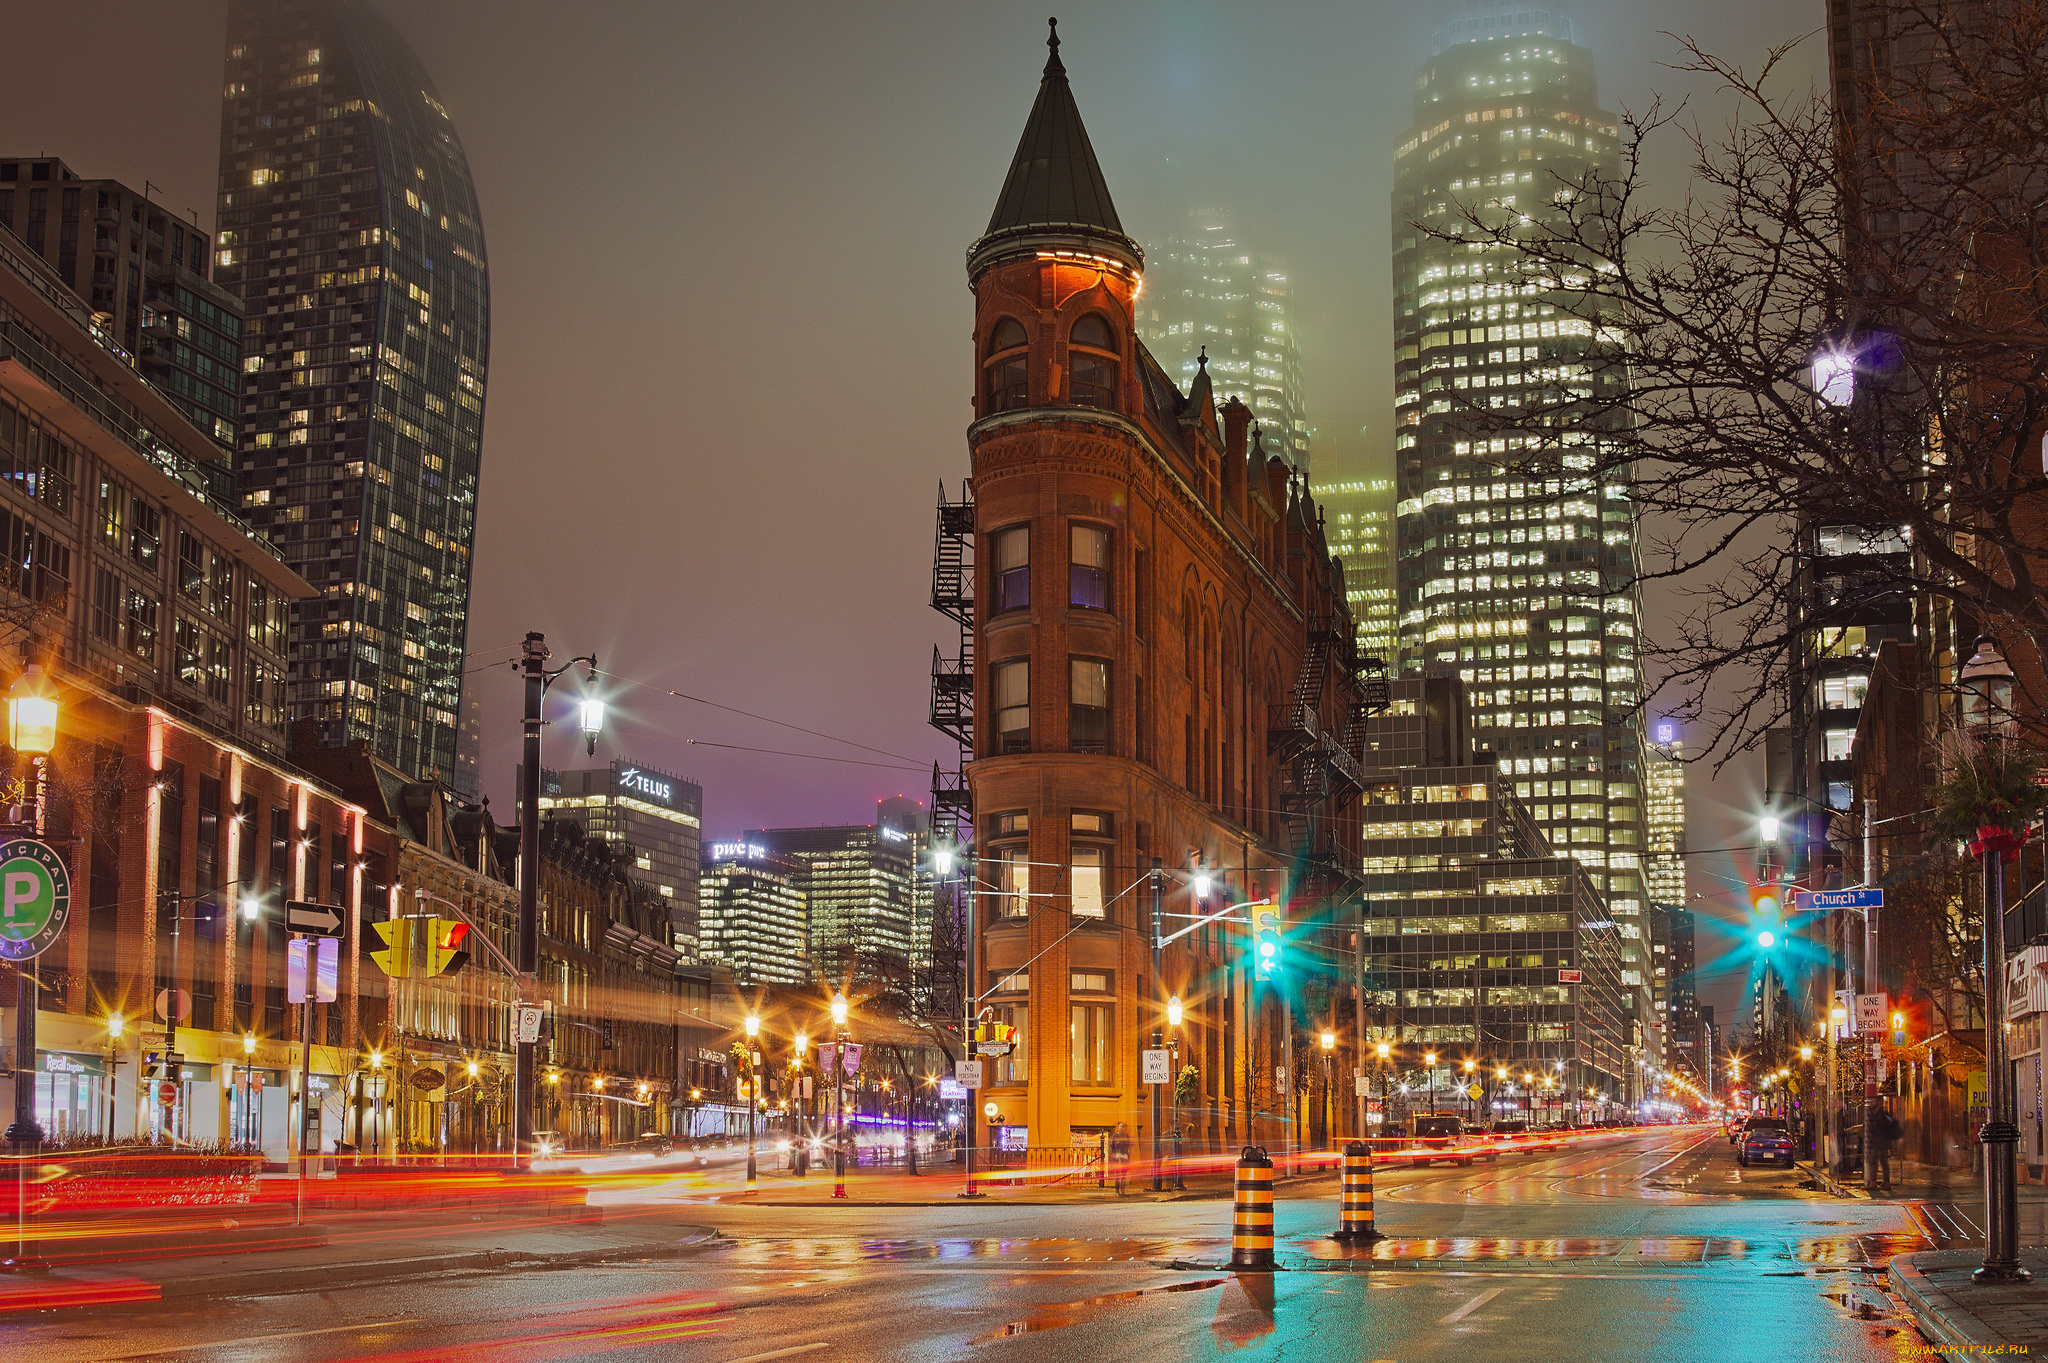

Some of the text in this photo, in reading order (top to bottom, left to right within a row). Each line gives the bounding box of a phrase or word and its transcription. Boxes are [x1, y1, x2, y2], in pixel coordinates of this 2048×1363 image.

[636, 775, 670, 799] TELUS
[713, 843, 746, 859] pwc
[748, 844, 765, 859] pwc
[3, 871, 40, 917] P
[1812, 892, 1856, 905] Church
[1863, 997, 1879, 1006] ONE
[1863, 1009, 1879, 1018] WAY
[1858, 1020, 1886, 1030] BEGINS
[1149, 1053, 1163, 1061] ONE
[46, 1054, 67, 1072] Rexall
[964, 1063, 974, 1072] NO
[1144, 1073, 1168, 1081] BEGINS
